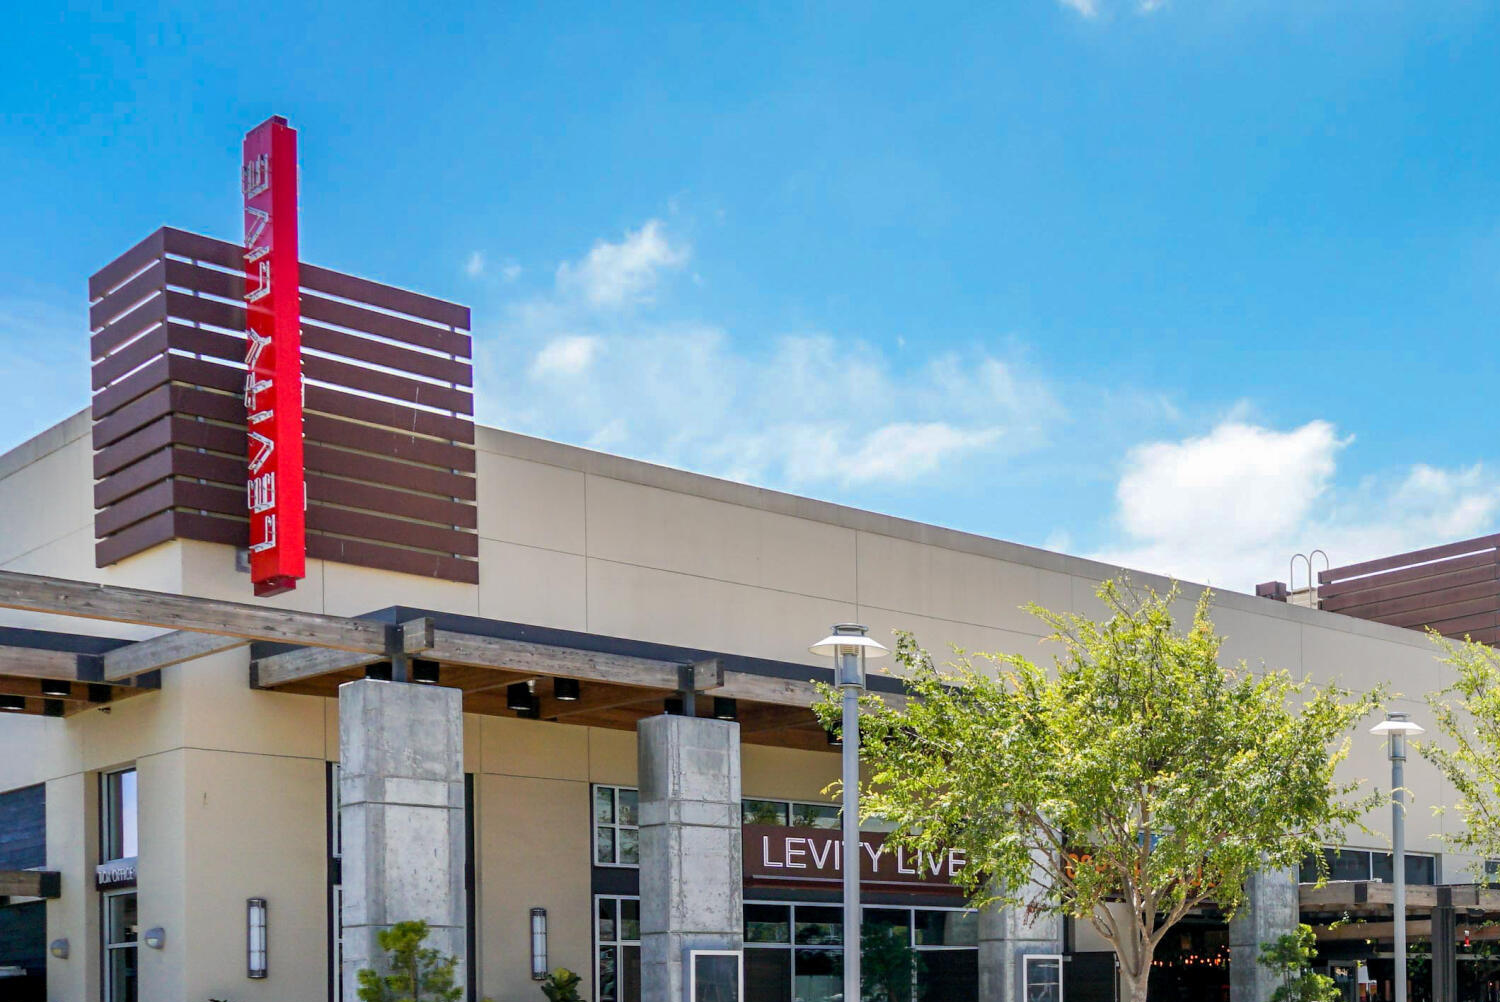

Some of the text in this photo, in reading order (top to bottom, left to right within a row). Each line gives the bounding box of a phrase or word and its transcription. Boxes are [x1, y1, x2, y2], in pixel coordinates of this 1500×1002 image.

[241, 152, 276, 554] LEVITY LIVE
[763, 836, 967, 877] LEVIY LIVE
